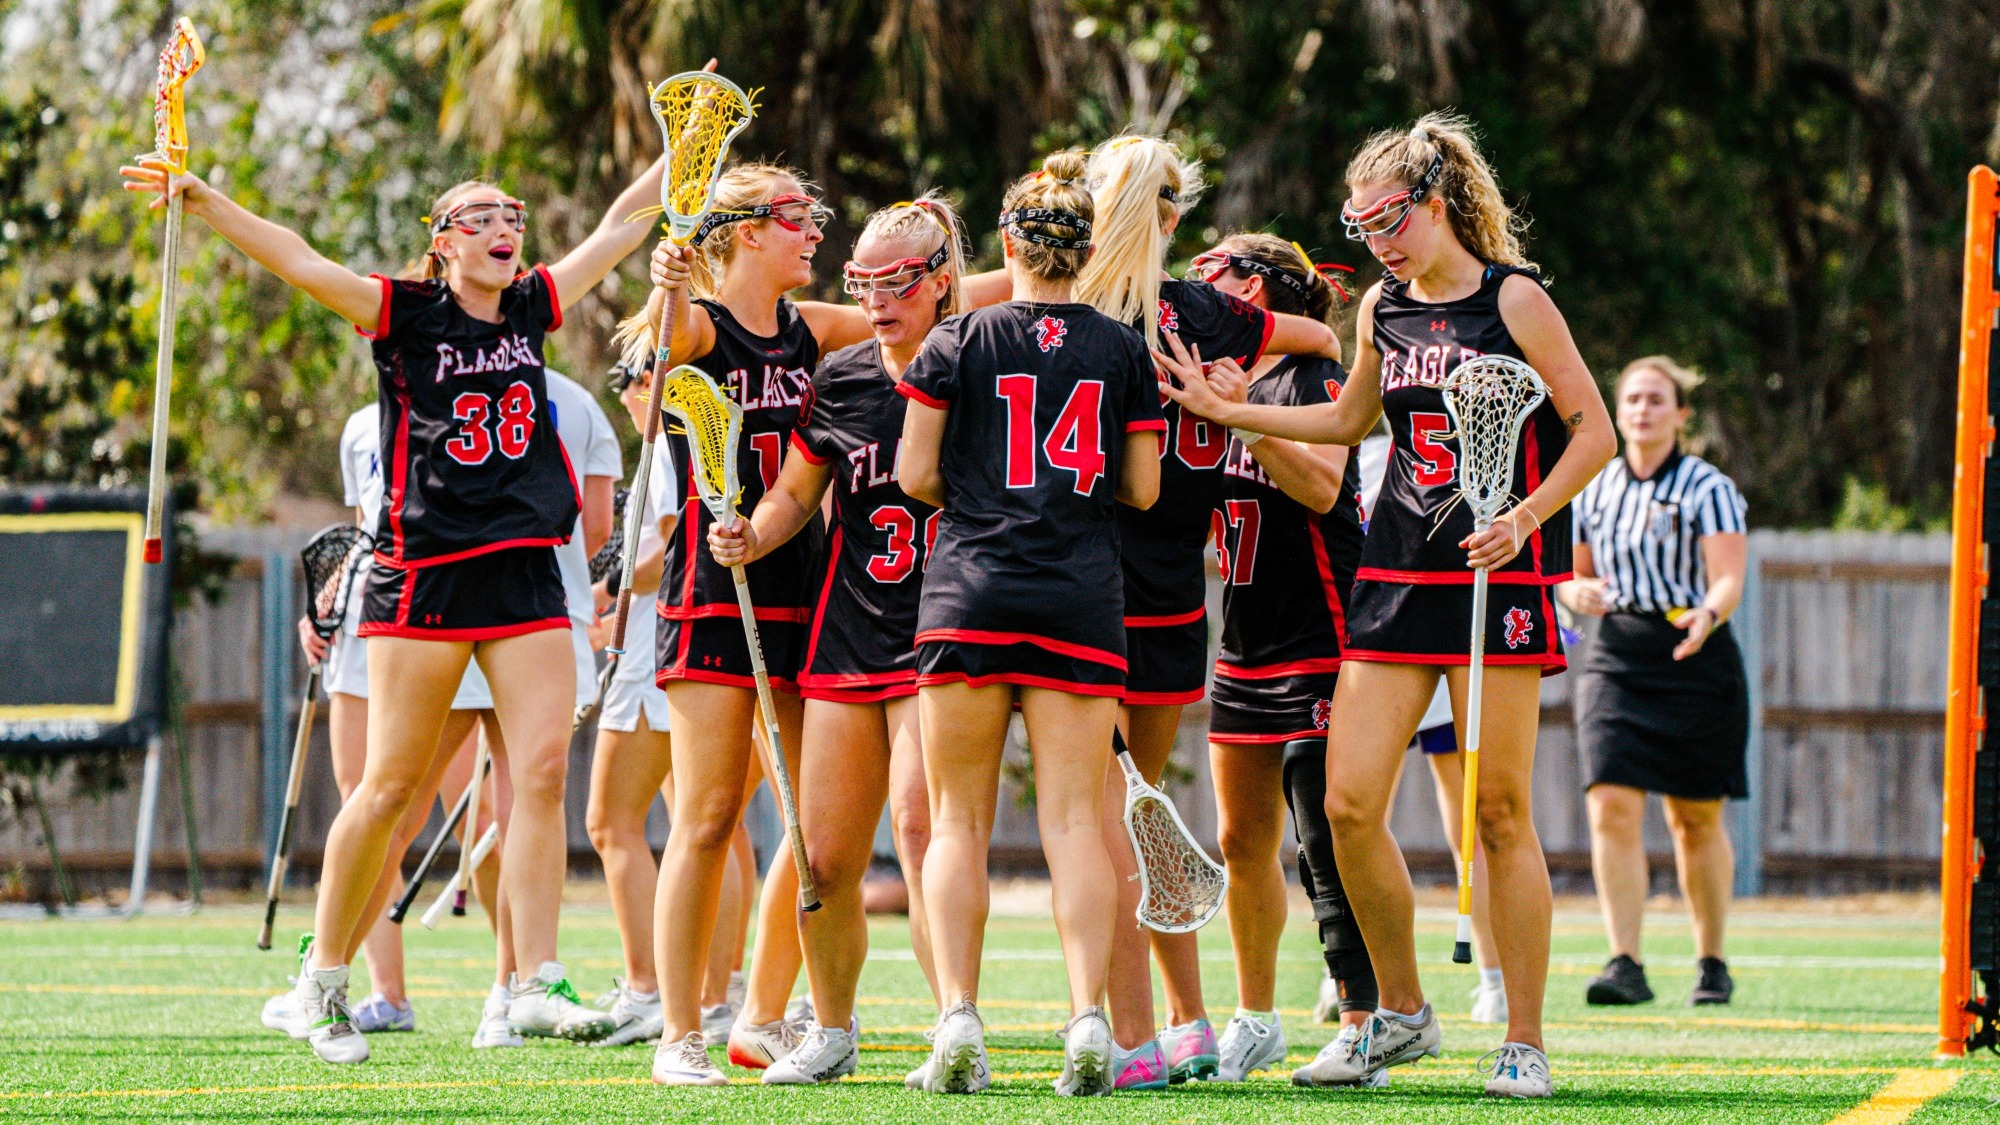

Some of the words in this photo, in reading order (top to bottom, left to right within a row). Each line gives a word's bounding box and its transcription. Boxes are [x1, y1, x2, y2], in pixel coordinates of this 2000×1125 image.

[1425, 161, 1441, 185] STX
[1411, 186, 1424, 202] TX
[753, 205, 771, 216] ST
[1027, 207, 1055, 218] STX
[699, 214, 722, 237] STX
[1032, 233, 1065, 247] STX
[931, 250, 944, 269] STX
[1240, 259, 1273, 275] STX
[445, 380, 536, 465] 38
[996, 373, 1105, 497] 14
[1410, 412, 1457, 487] 5
[1384, 1032, 1422, 1058] balance
